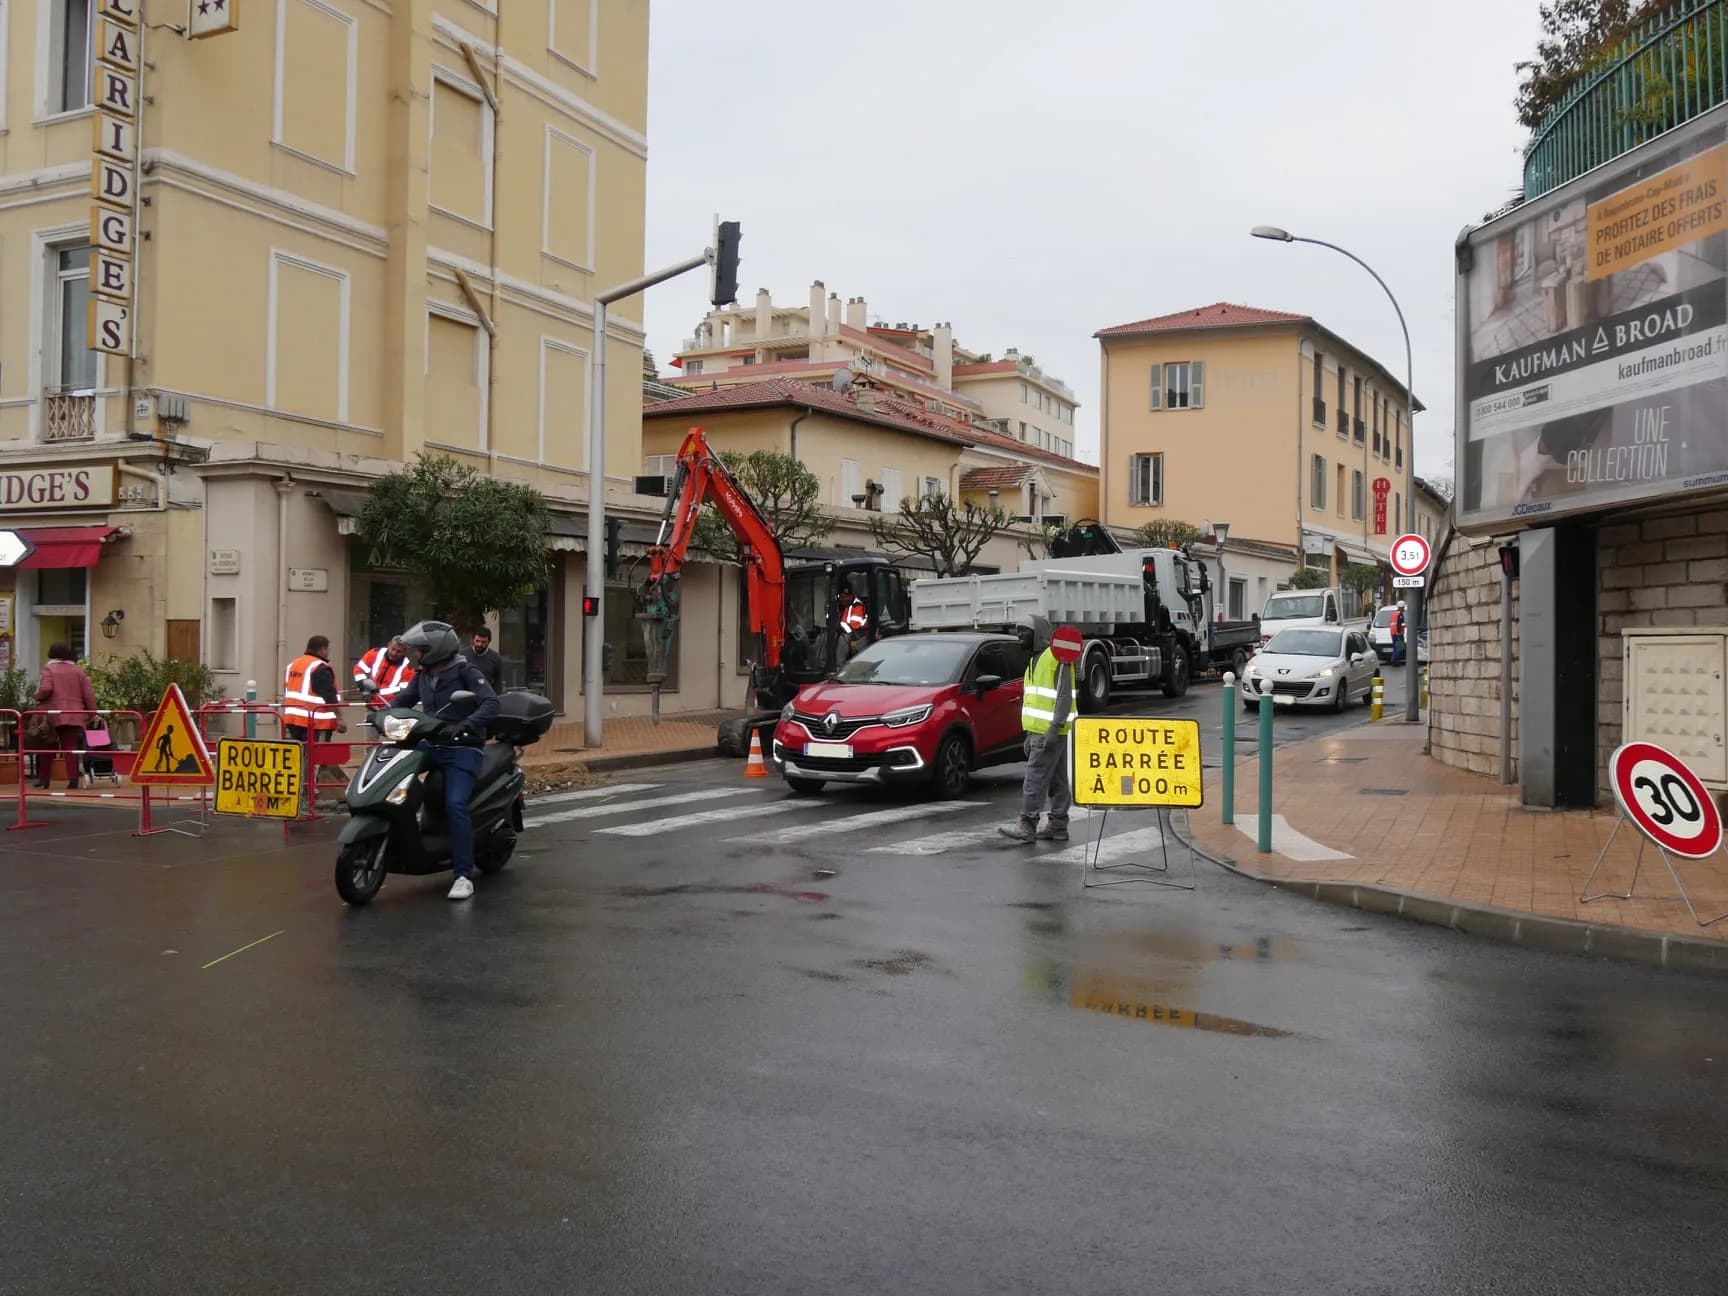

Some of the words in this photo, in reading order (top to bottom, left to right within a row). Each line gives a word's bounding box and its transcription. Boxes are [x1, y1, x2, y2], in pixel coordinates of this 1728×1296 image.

[1596, 207, 1649, 246] PROFITEZ
[1652, 198, 1677, 222] DES
[1679, 179, 1718, 210] FRAIS
[1596, 248, 1613, 267] DE
[1615, 226, 1665, 261] NOTAIRE
[1495, 337, 1586, 386] KAUFMAN
[1615, 303, 1694, 348] BROAD
[1634, 405, 1672, 444] UNE
[1567, 442, 1668, 484] COLLECTION
[1512, 501, 1552, 516] JCDecaux
[1397, 578, 1411, 586] 150
[1098, 728, 1176, 745] ROUTE
[227, 745, 293, 770] ROUTE
[1089, 750, 1185, 770] BARRÉE
[222, 770, 297, 796] BARRÉE
[1093, 774, 1105, 794] À
[1121, 776, 1168, 794] 00
[1174, 784, 1188, 795] m
[1634, 773, 1701, 826] 30
